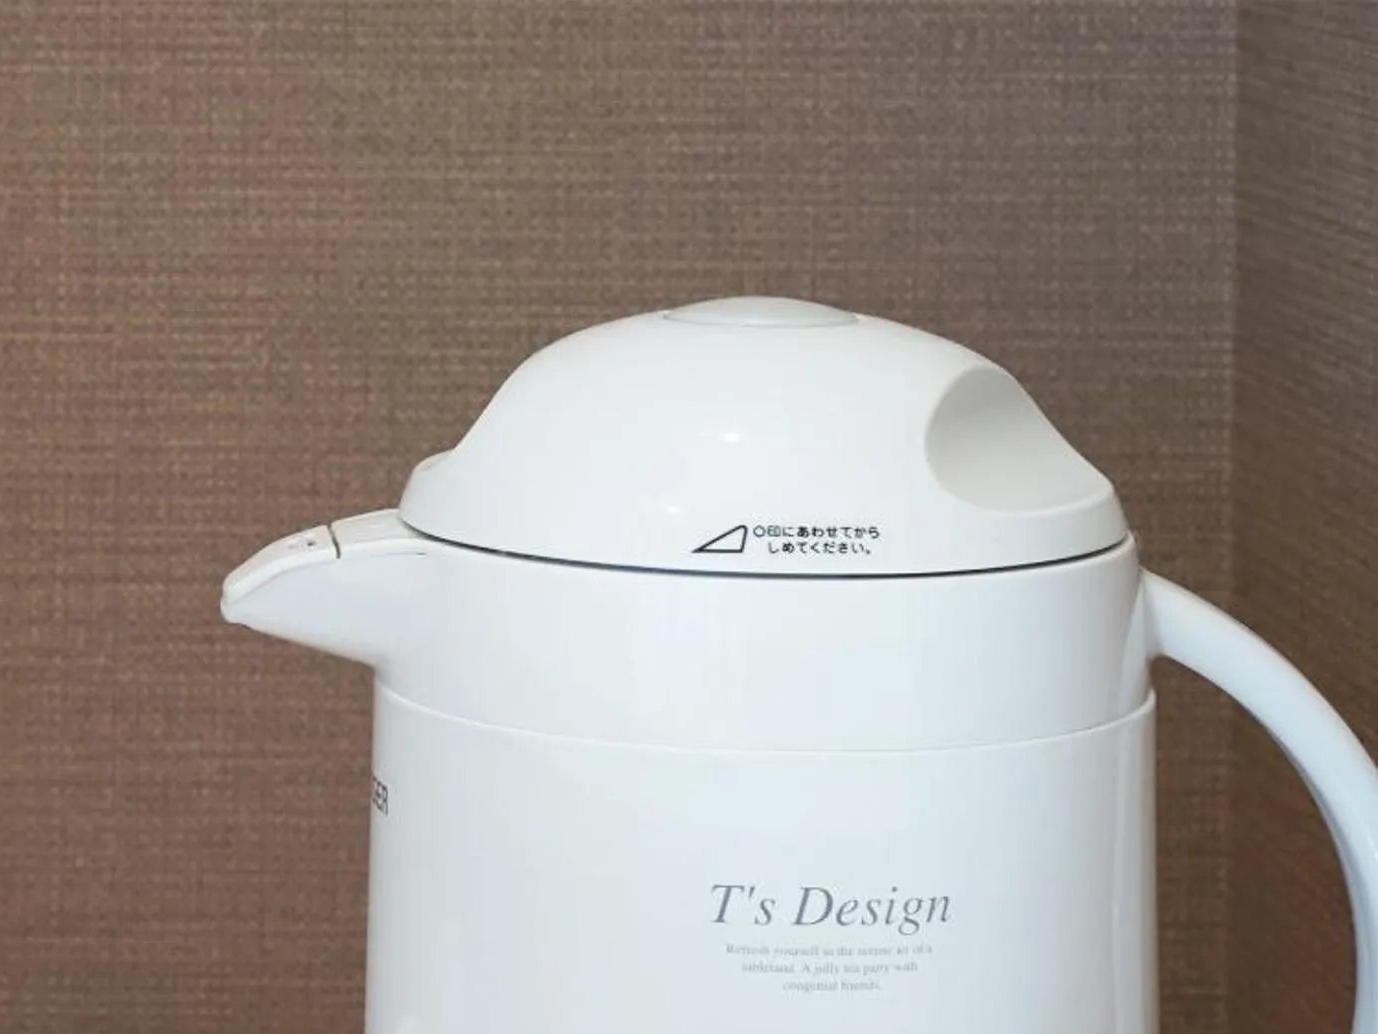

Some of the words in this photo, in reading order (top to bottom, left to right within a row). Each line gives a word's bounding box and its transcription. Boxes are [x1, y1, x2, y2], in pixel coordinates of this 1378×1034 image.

[768, 541, 872, 555] しめてください。
[710, 883, 776, 925] T's
[791, 885, 951, 936] Design
